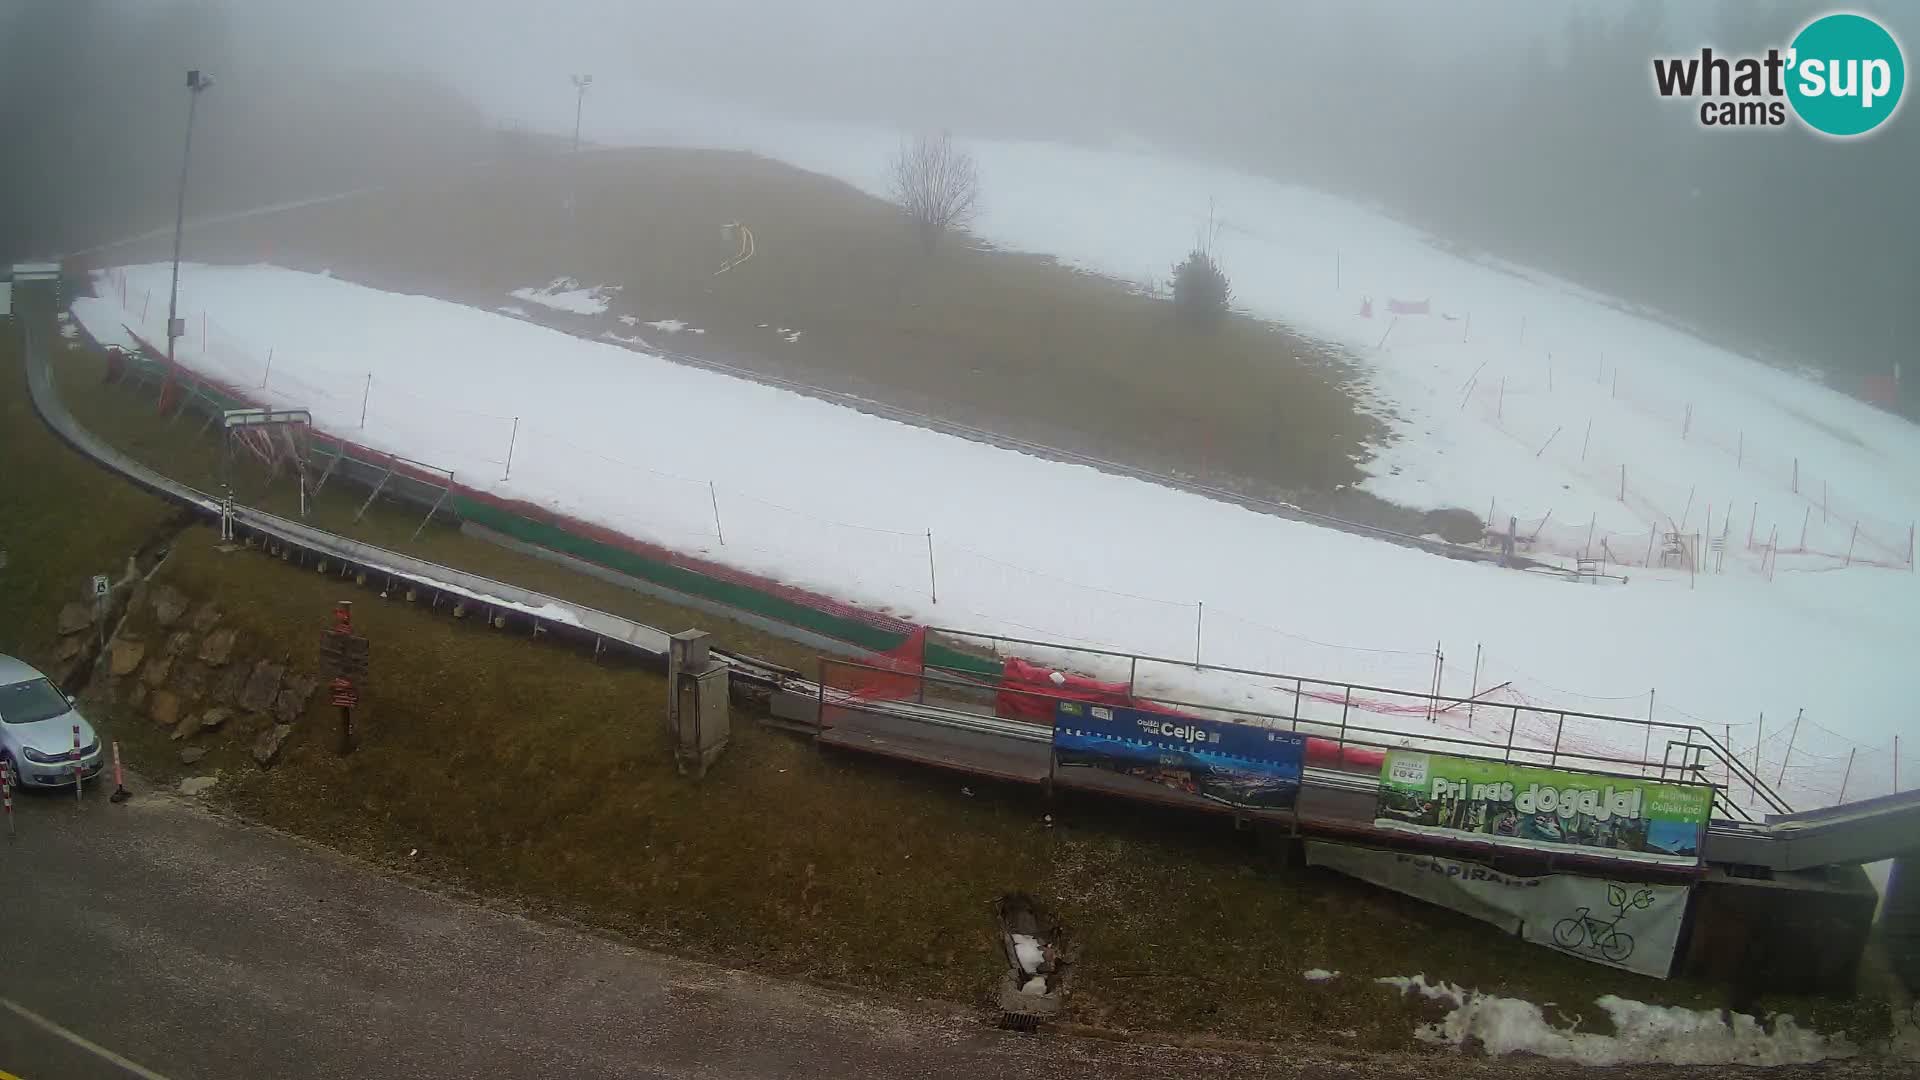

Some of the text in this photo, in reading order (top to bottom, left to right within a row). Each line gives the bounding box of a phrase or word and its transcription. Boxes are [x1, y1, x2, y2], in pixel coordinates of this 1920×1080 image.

[1143, 726, 1160, 736] Visit
[1161, 722, 1206, 744] Celje
[1431, 777, 1468, 801] Pri
[1471, 781, 1513, 802] nas
